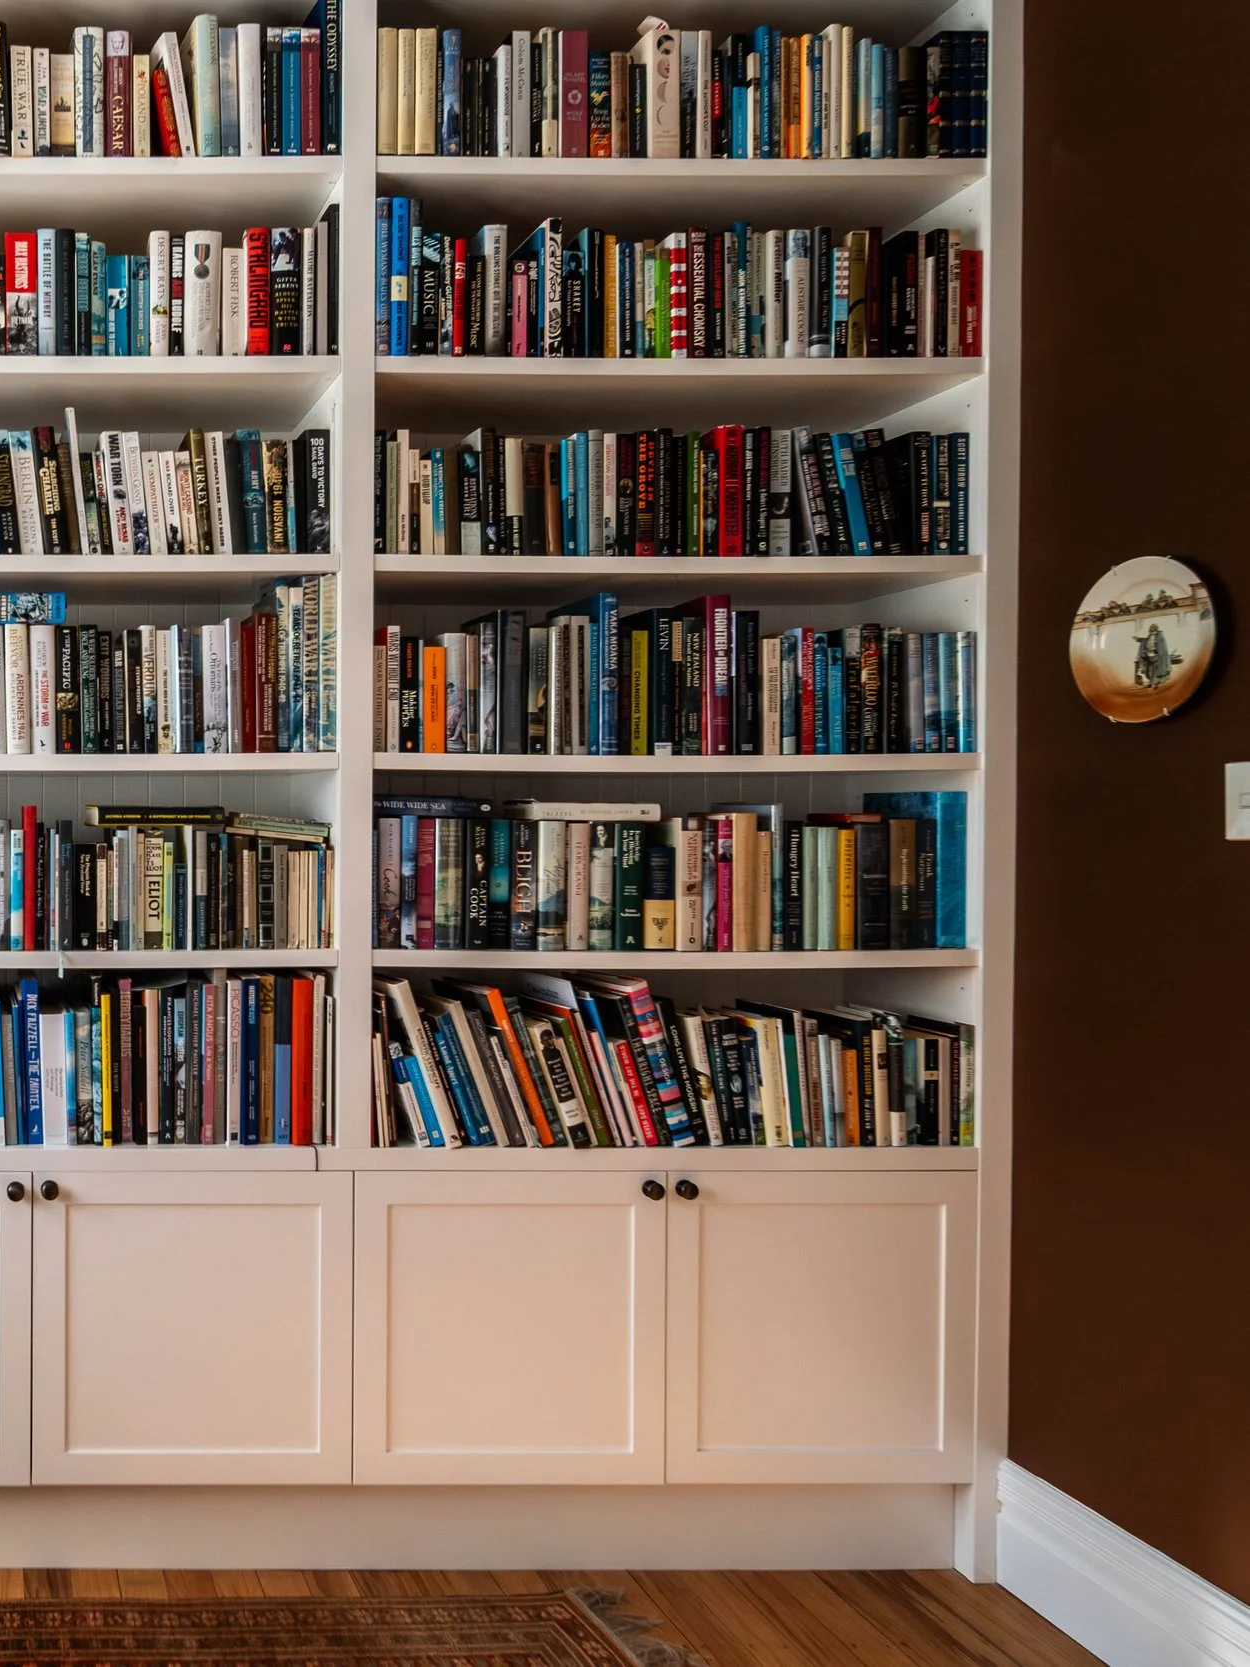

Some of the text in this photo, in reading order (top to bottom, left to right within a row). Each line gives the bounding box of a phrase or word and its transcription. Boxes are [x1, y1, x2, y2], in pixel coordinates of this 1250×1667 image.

[326, 0, 338, 70] THE ODYSSEY
[16, 50, 26, 120] TRUE WAR
[112, 96, 124, 150] CAESAR
[14, 242, 28, 289] MAX HASTINGS
[42, 238, 52, 318] THE BATTLE OF MIDWAY
[156, 236, 166, 300] DESERT RATS
[248, 234, 268, 328] STALINGRAD
[773, 236, 783, 304] Arthur Miller
[422, 270, 436, 314] MUSIC
[572, 280, 581, 312] SHAKEY
[692, 252, 706, 348] ESSENTIAL CHOMSKY
[108, 434, 122, 486] WAR TORN
[310, 438, 324, 446] 100
[956, 438, 966, 488] SCOTT TUROW
[195, 456, 206, 506] TURKEY
[316, 447, 325, 508] DAYS TO VICTORY
[638, 434, 646, 508] THE GROVE
[646, 487, 654, 501] IN
[273, 474, 284, 542] INVASION 1940
[302, 581, 318, 634] WORLD
[9, 629, 18, 669] BEEVOR
[303, 638, 319, 674] WAR
[659, 618, 668, 650] LEVIN
[714, 608, 728, 696] FRONTIER DREAMS
[62, 648, 72, 689] PACIFIC
[143, 654, 154, 696] VERDUN
[388, 632, 400, 701] WARS WITHOUT END
[16, 673, 24, 740] ARDENNES 1944
[408, 690, 417, 719] Making
[382, 869, 397, 896] Cook
[515, 851, 531, 913] BLIGH
[788, 834, 799, 896] Hungry Heart
[149, 882, 160, 920] ELIOT
[468, 888, 478, 919] COOK
[477, 880, 486, 926] CAPTAIN
[204, 996, 213, 1041] RITA ANGUS
[230, 989, 240, 1038] PICASSO
[261, 982, 273, 1014] 240
[670, 1026, 696, 1112] LONG LIVE THE MODERN
